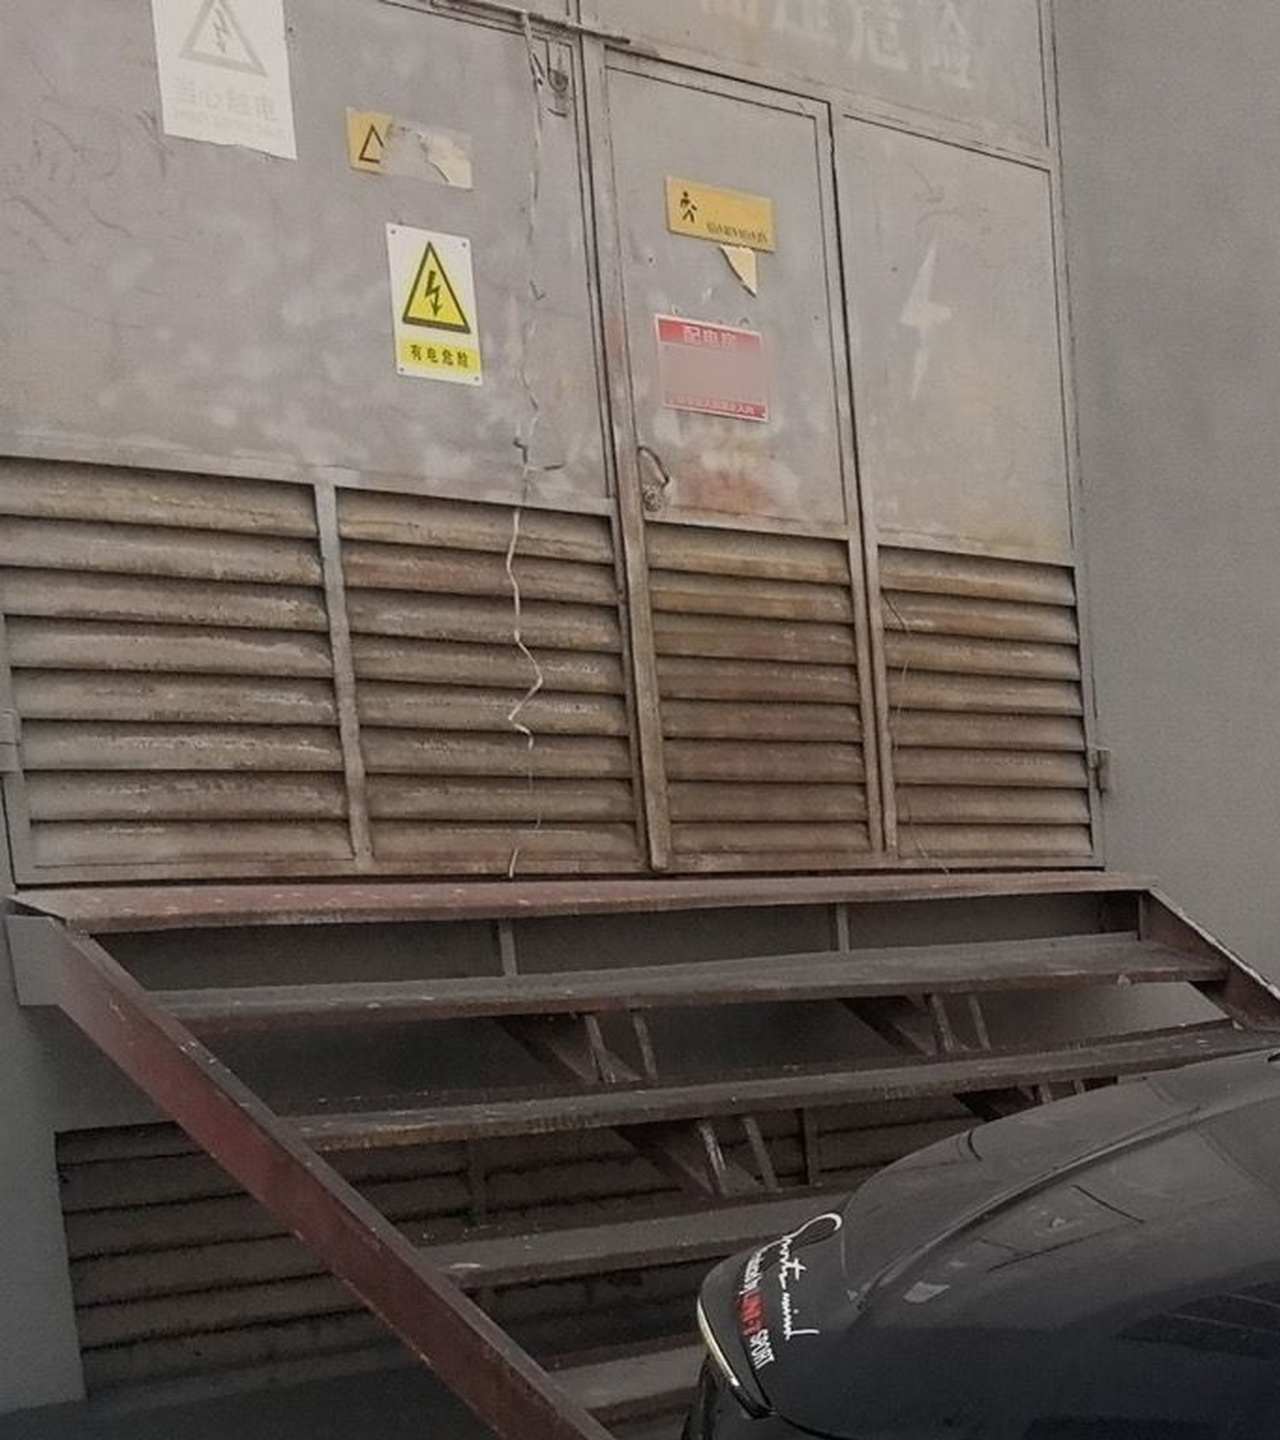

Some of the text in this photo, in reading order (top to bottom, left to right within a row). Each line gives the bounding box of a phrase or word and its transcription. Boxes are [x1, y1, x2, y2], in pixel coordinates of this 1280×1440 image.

[410, 343, 469, 368] 有电危险
[750, 1328, 775, 1370] SPORT
